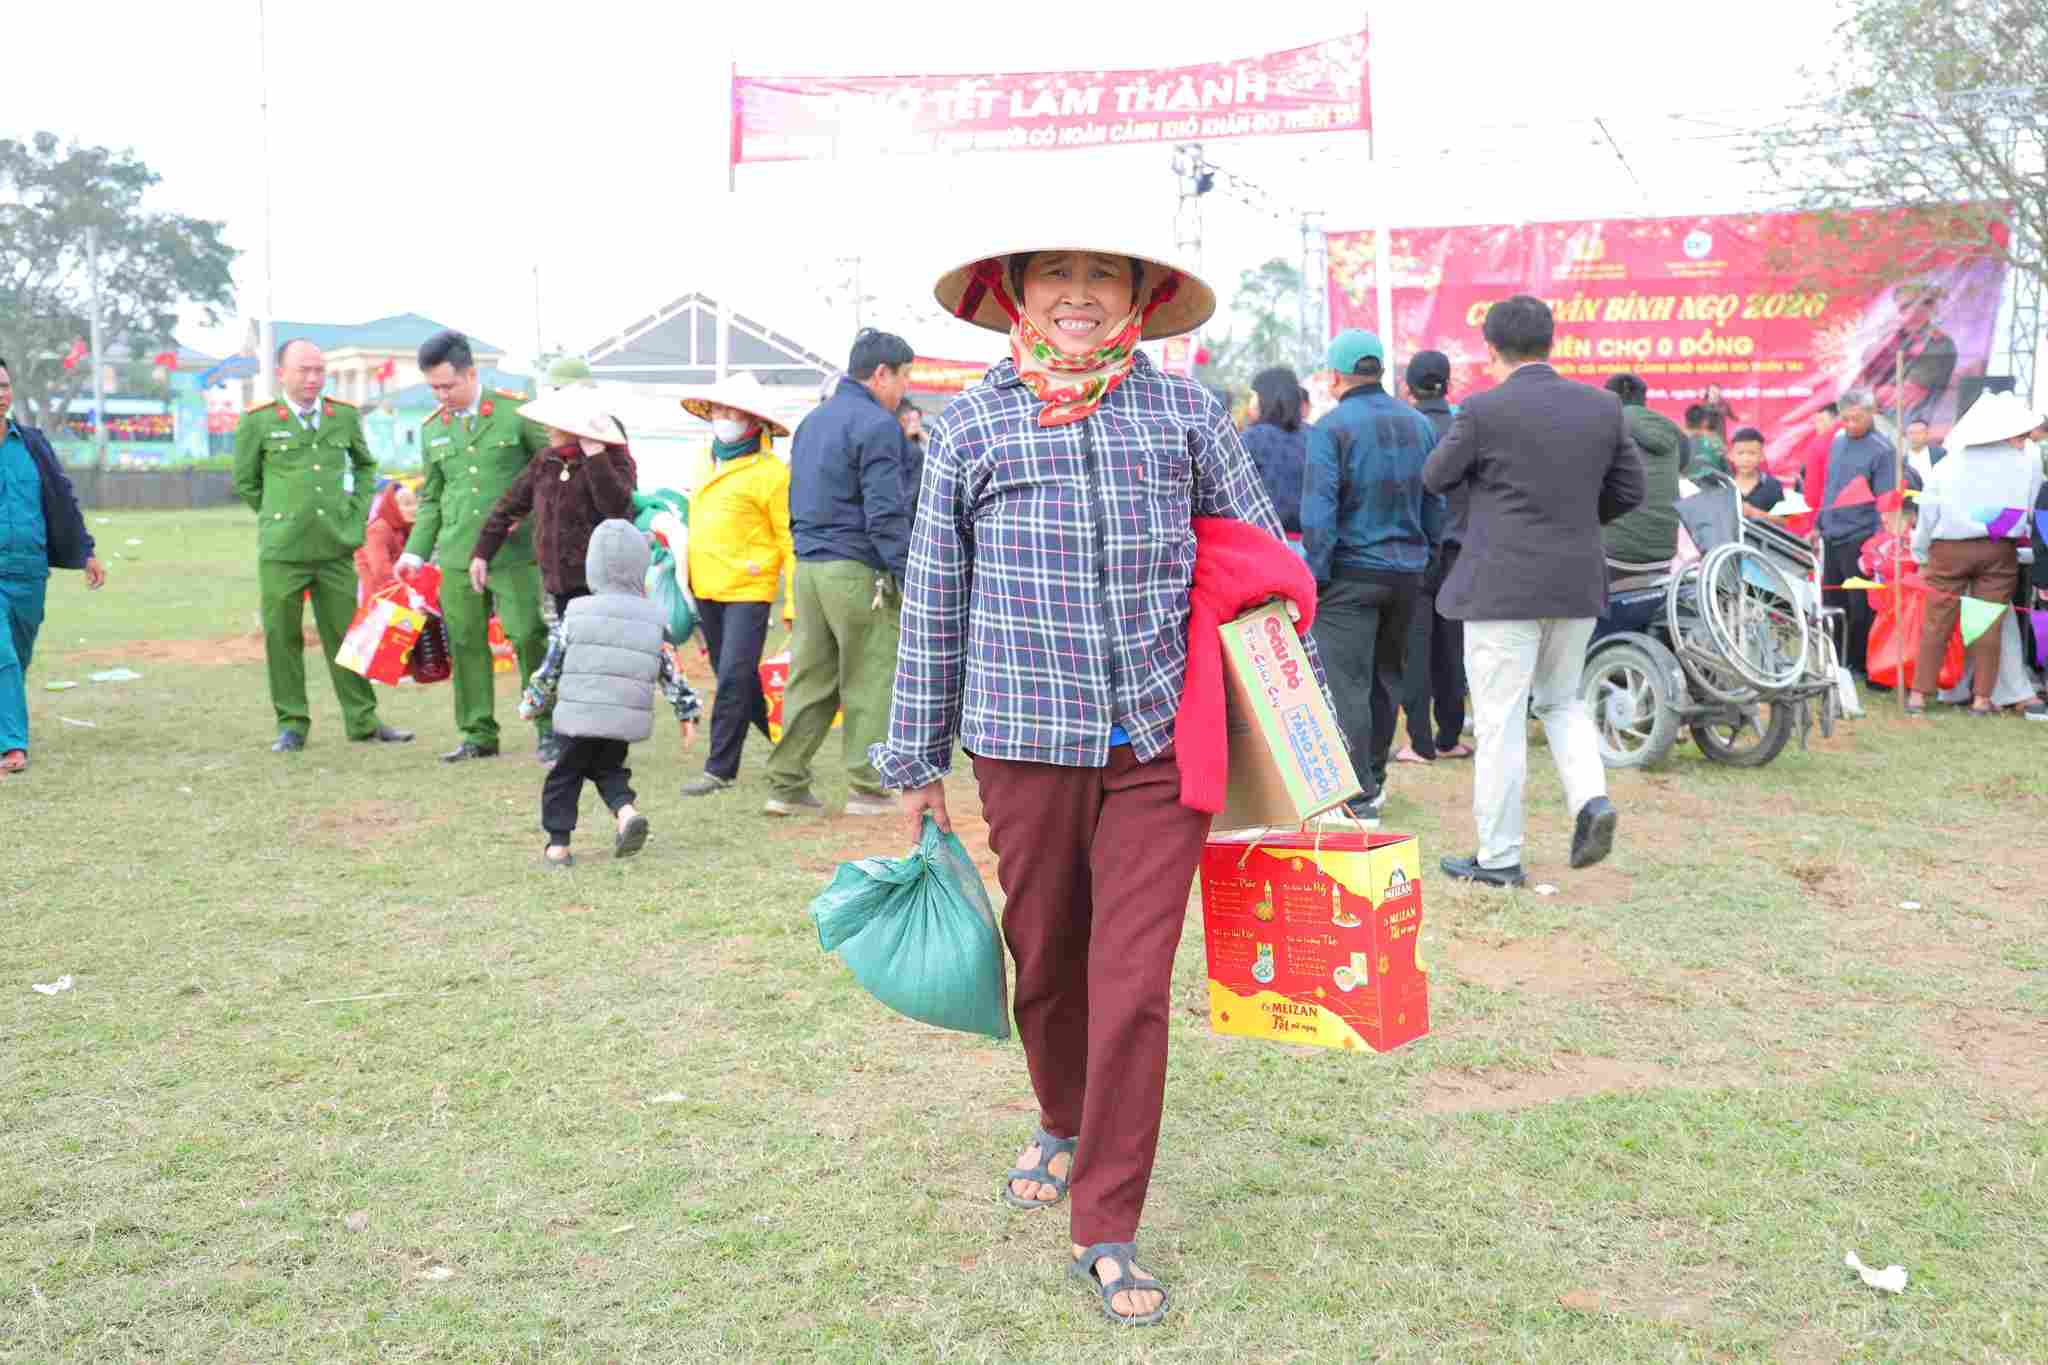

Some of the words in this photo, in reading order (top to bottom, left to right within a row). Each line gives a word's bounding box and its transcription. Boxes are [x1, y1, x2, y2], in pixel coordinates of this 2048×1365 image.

[1006, 84, 1103, 117] LÂM
[1112, 66, 1268, 113] THÀNH
[1678, 292, 1739, 328] NGỌ
[1597, 336, 1653, 362] CHỢ
[1272, 1002, 1319, 1018] MEIZAN
